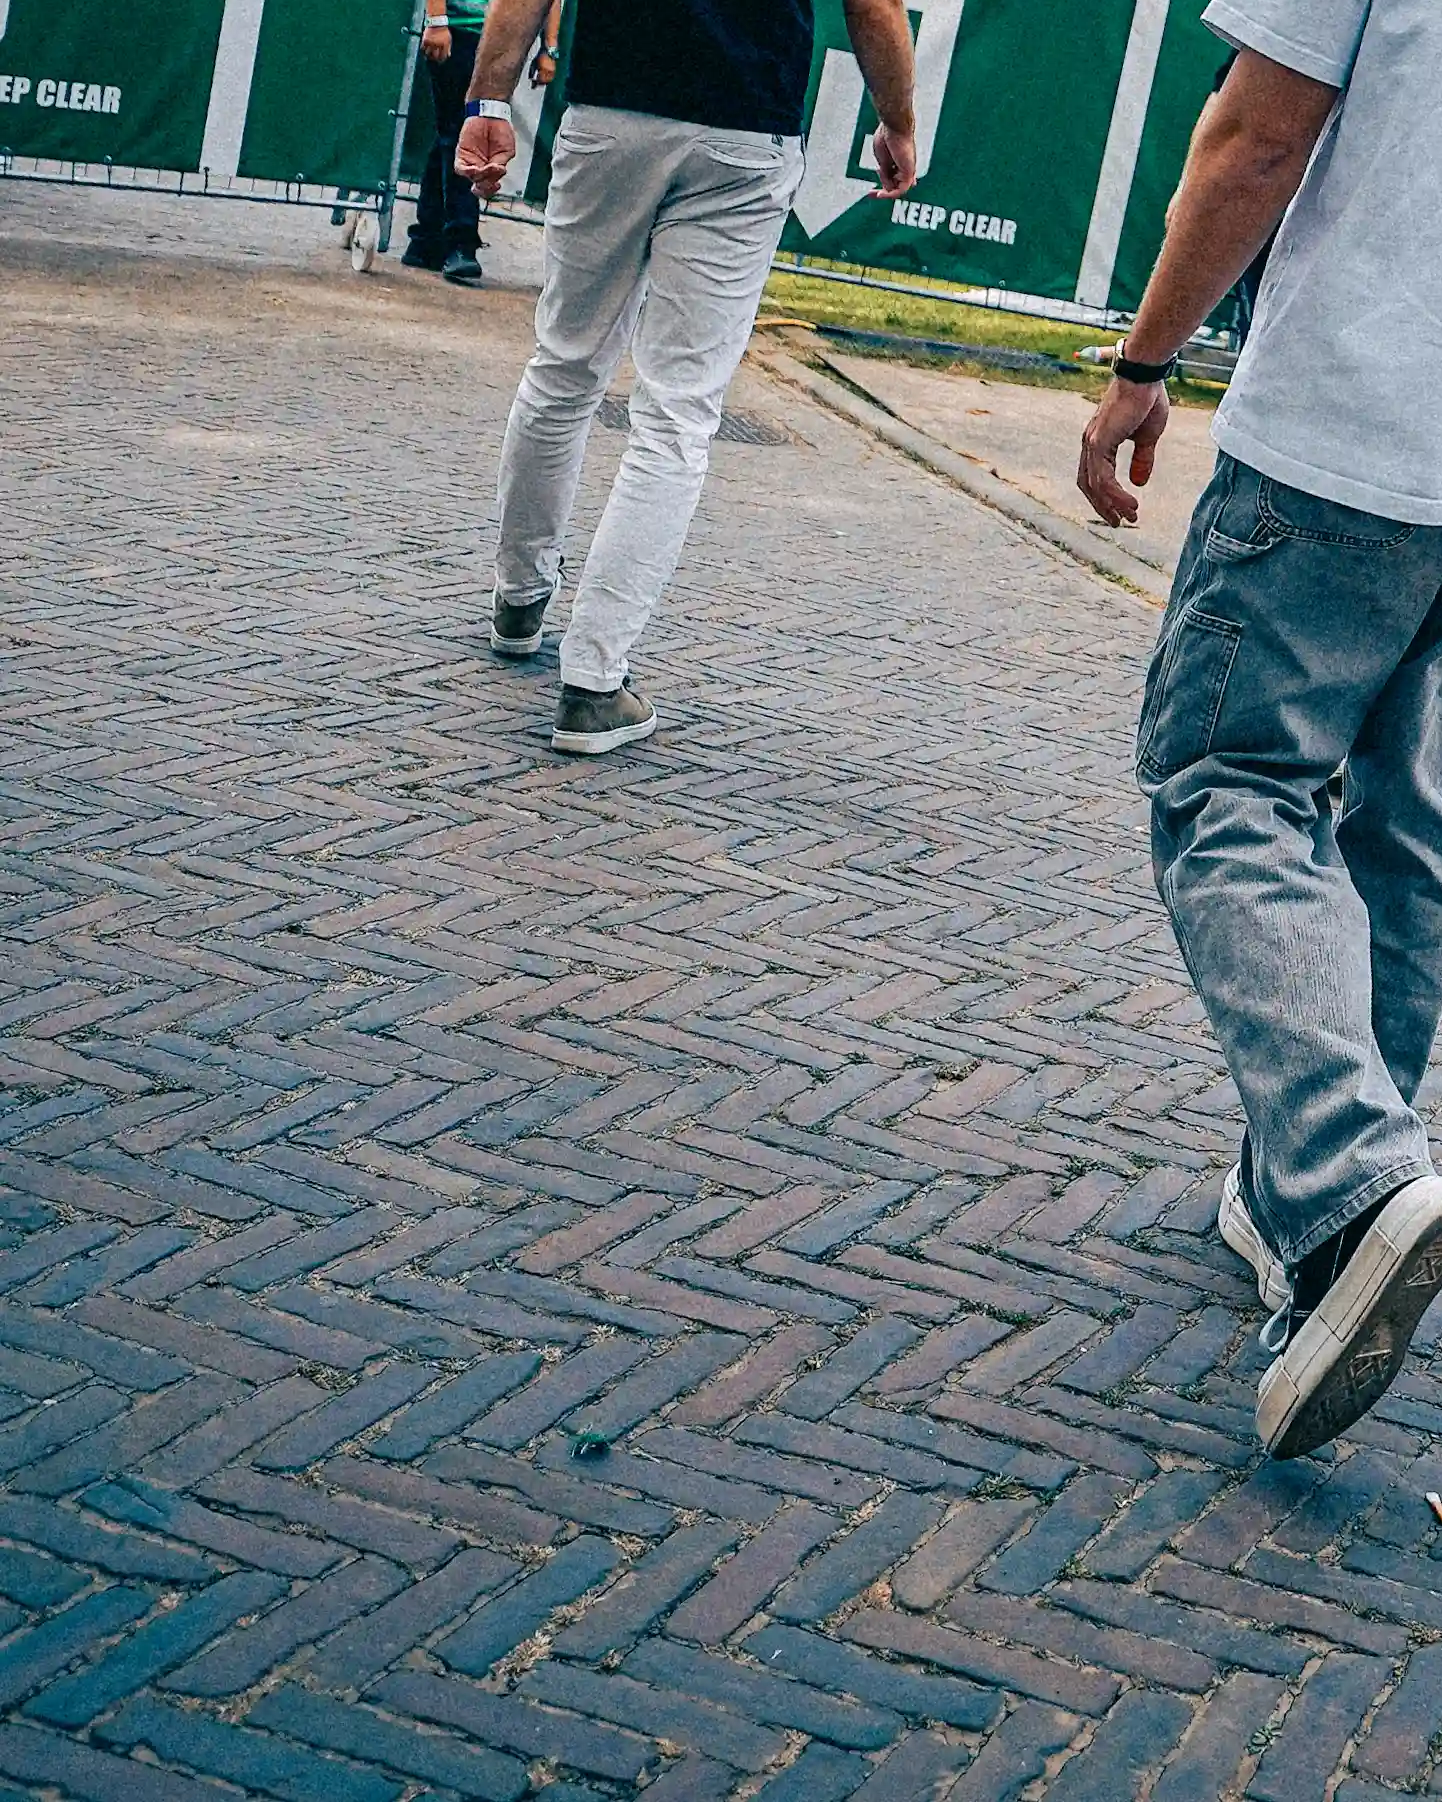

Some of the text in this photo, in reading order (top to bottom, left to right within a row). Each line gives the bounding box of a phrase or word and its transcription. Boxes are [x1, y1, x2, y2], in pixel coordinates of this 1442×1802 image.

[36, 79, 122, 114] CLEAR
[891, 198, 1018, 245] KEEP CLEAR
